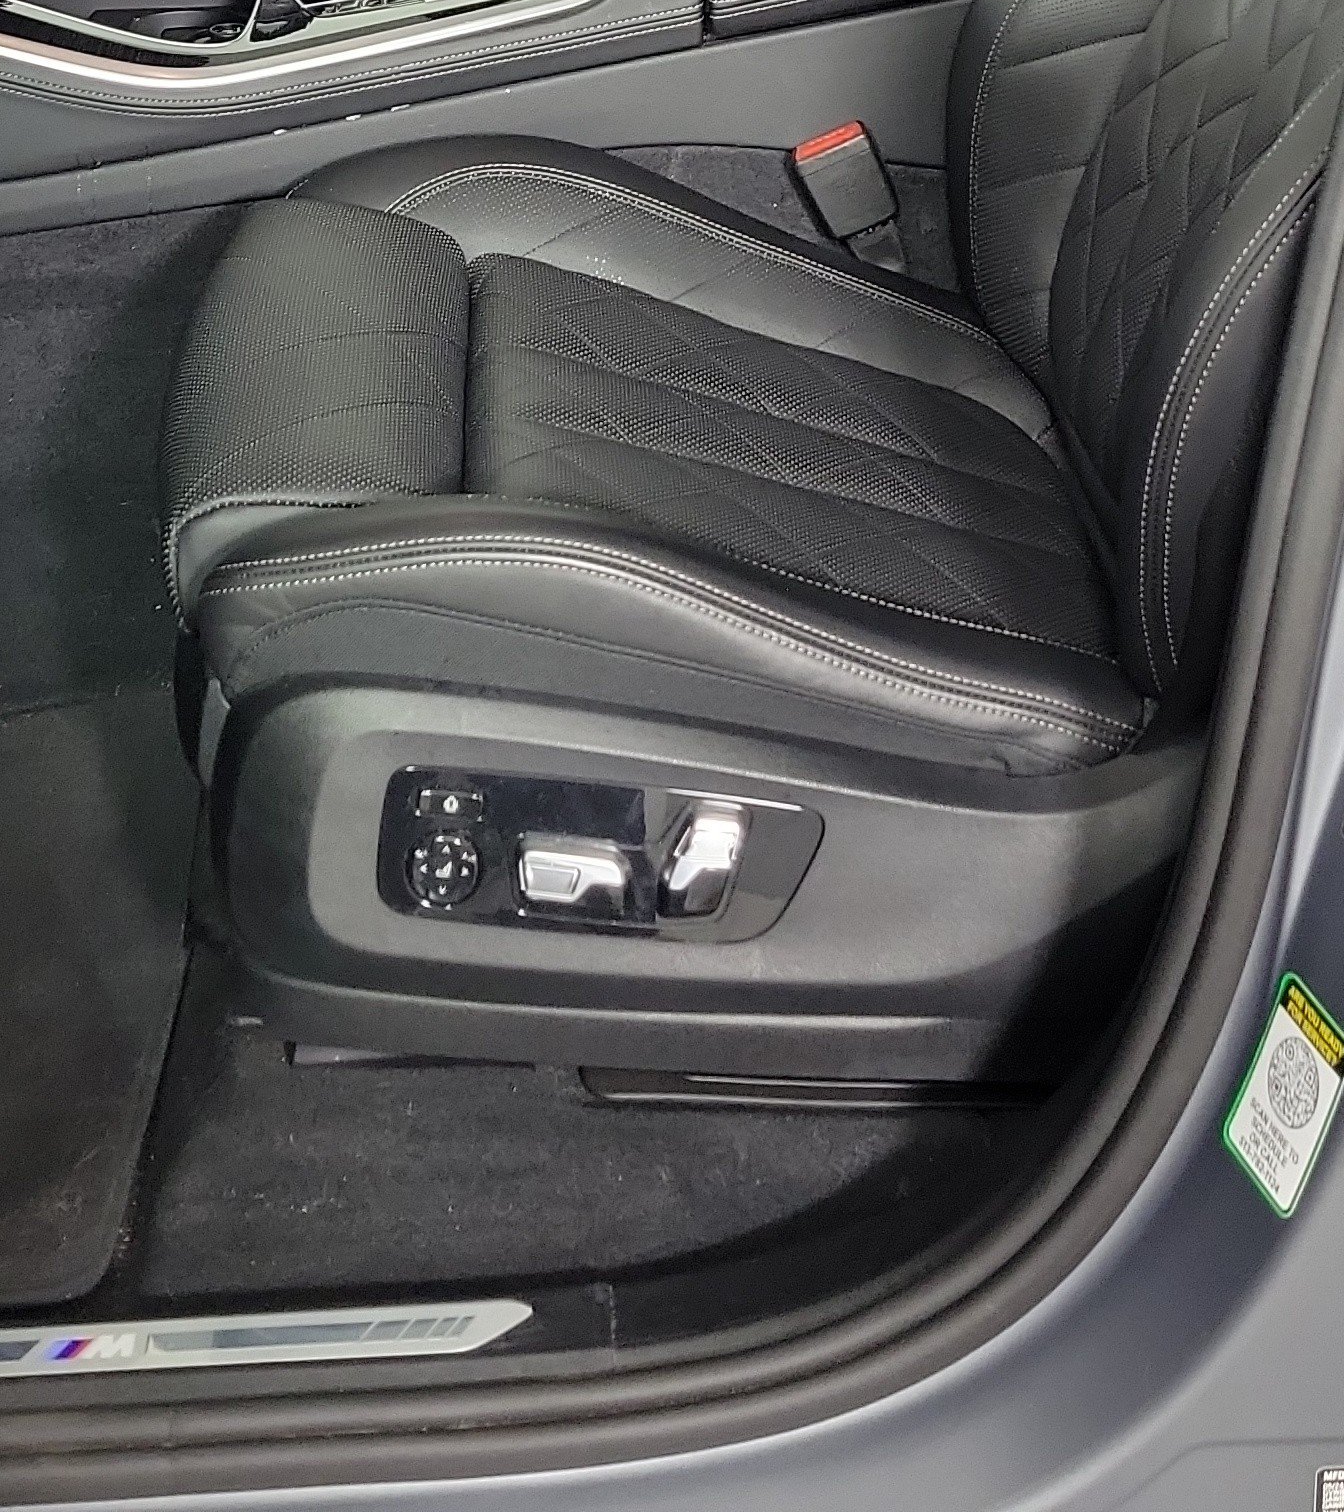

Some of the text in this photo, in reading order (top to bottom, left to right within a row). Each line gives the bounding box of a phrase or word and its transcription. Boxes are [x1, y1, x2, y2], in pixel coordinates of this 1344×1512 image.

[1304, 1001, 1322, 1028] YOU
[1249, 1130, 1277, 1174] OR CALL
[1250, 1096, 1299, 1165] SCAN HERE TO
[1250, 1115, 1288, 1168] SCHEDULE
